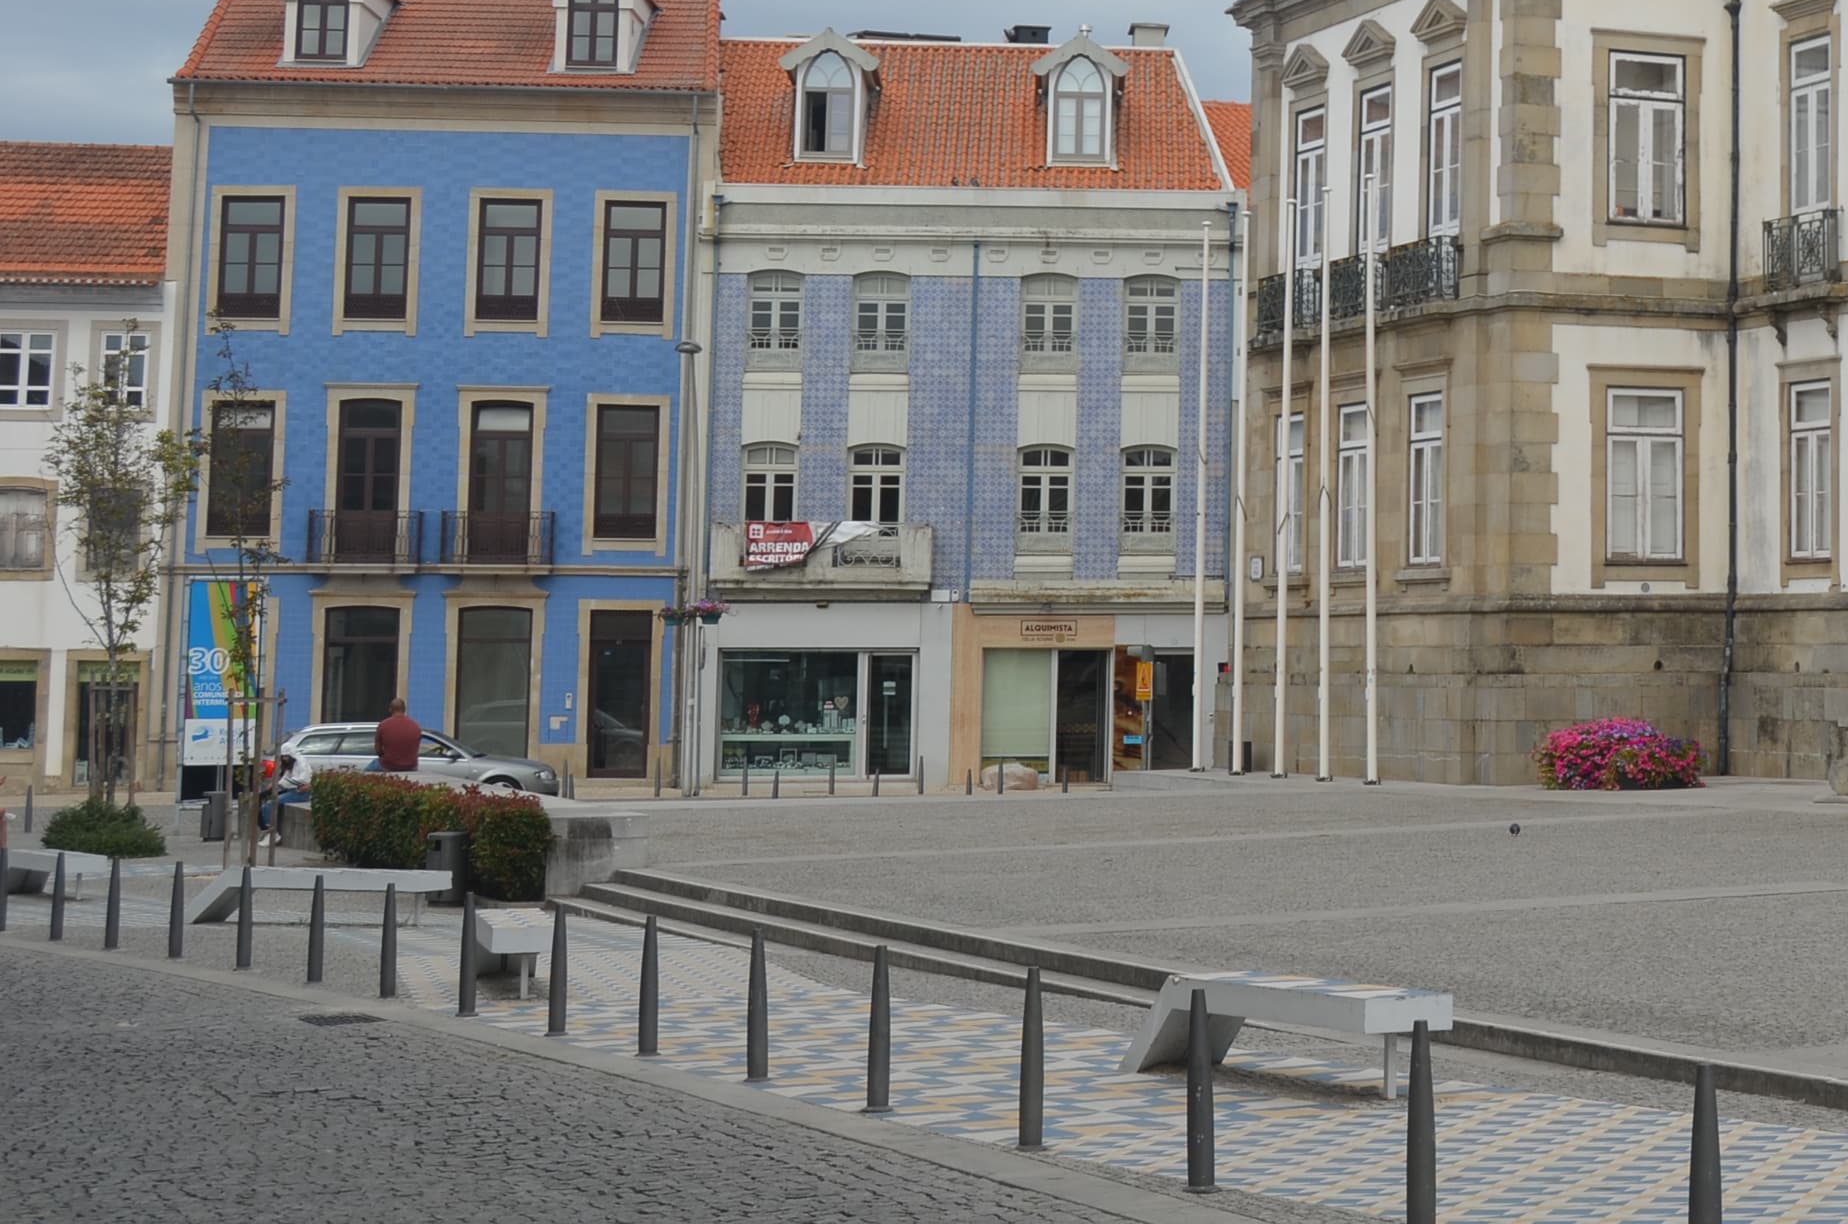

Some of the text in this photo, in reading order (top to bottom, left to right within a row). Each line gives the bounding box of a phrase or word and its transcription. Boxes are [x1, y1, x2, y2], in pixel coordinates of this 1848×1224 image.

[749, 542, 809, 553] ARRENDA
[1025, 624, 1073, 632] ALQUIMISTA
[188, 647, 230, 674] 30
[194, 682, 222, 691] anos
